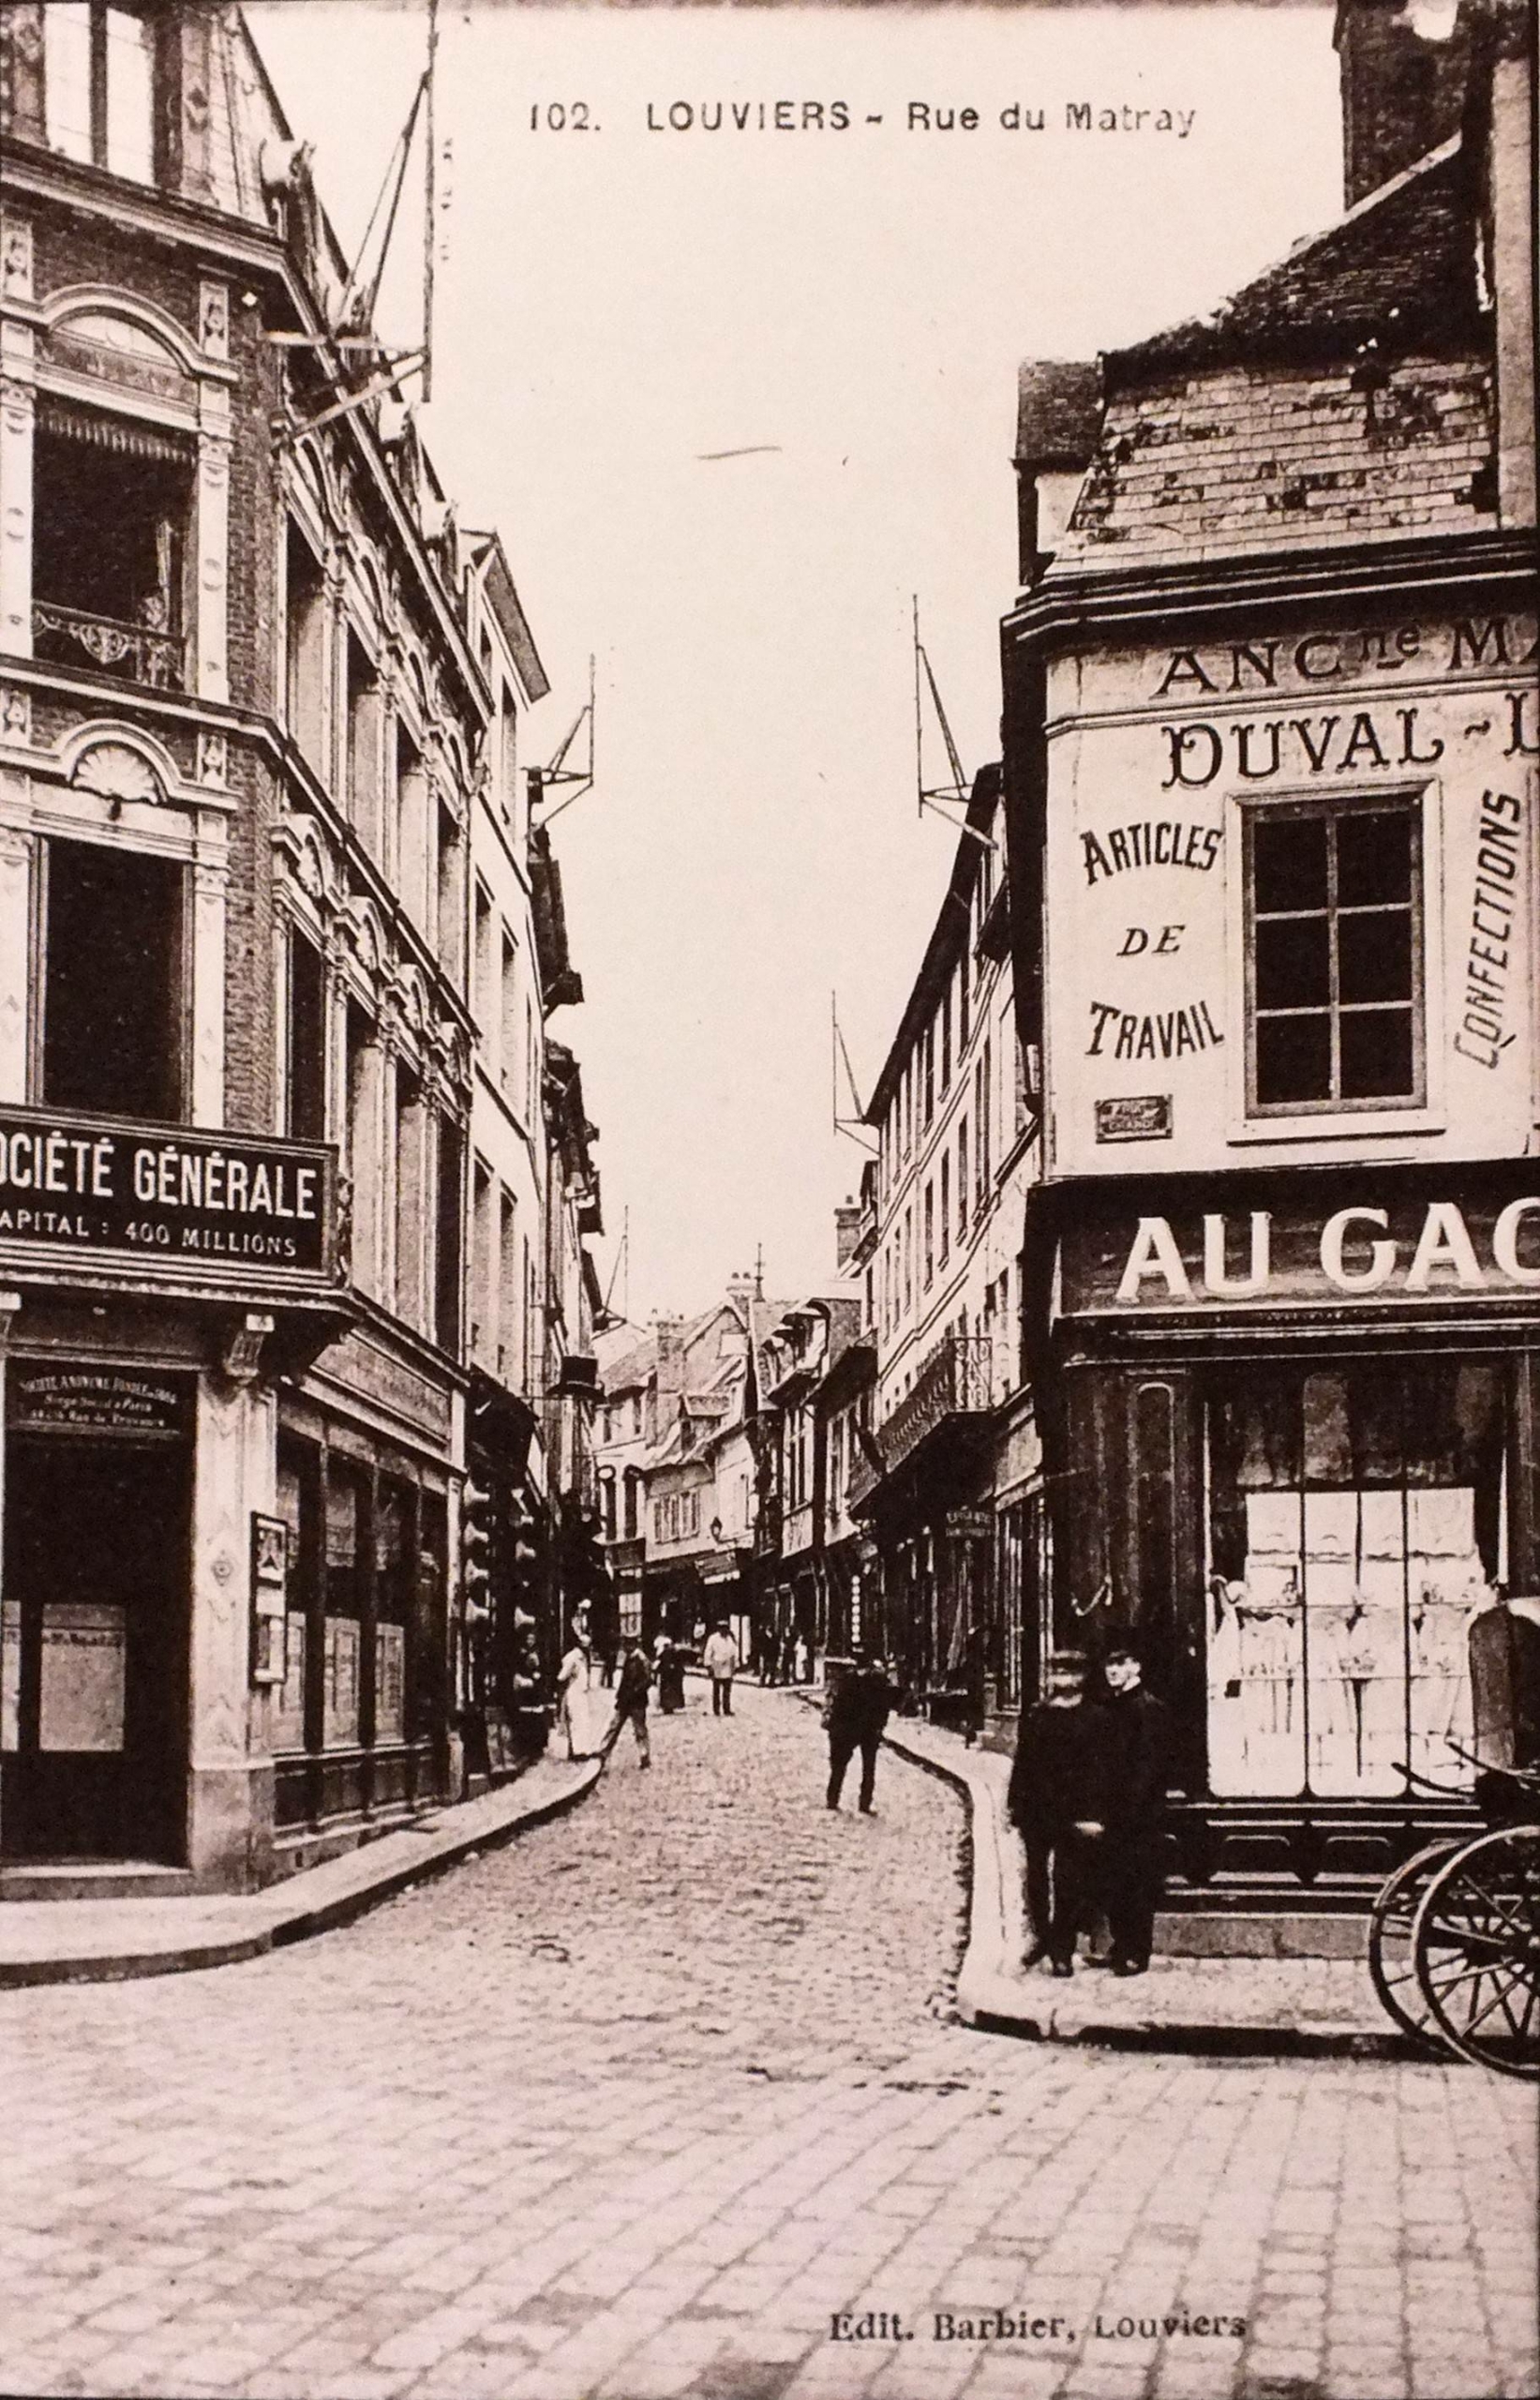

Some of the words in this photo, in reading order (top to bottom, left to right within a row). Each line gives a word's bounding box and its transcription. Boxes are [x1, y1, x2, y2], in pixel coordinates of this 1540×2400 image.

[1446, 614, 1540, 671] M
[1080, 821, 1224, 886] ARTICLES
[1116, 924, 1186, 957] DE
[1453, 788, 1520, 1071] CONFECTIONS
[1084, 1000, 1225, 1060] TRAVAIL
[134, 1145, 317, 1220] GÉNÉRALE
[125, 1222, 171, 1244] 400
[182, 1228, 297, 1257] MILLIONS
[1115, 1212, 1272, 1304] AU
